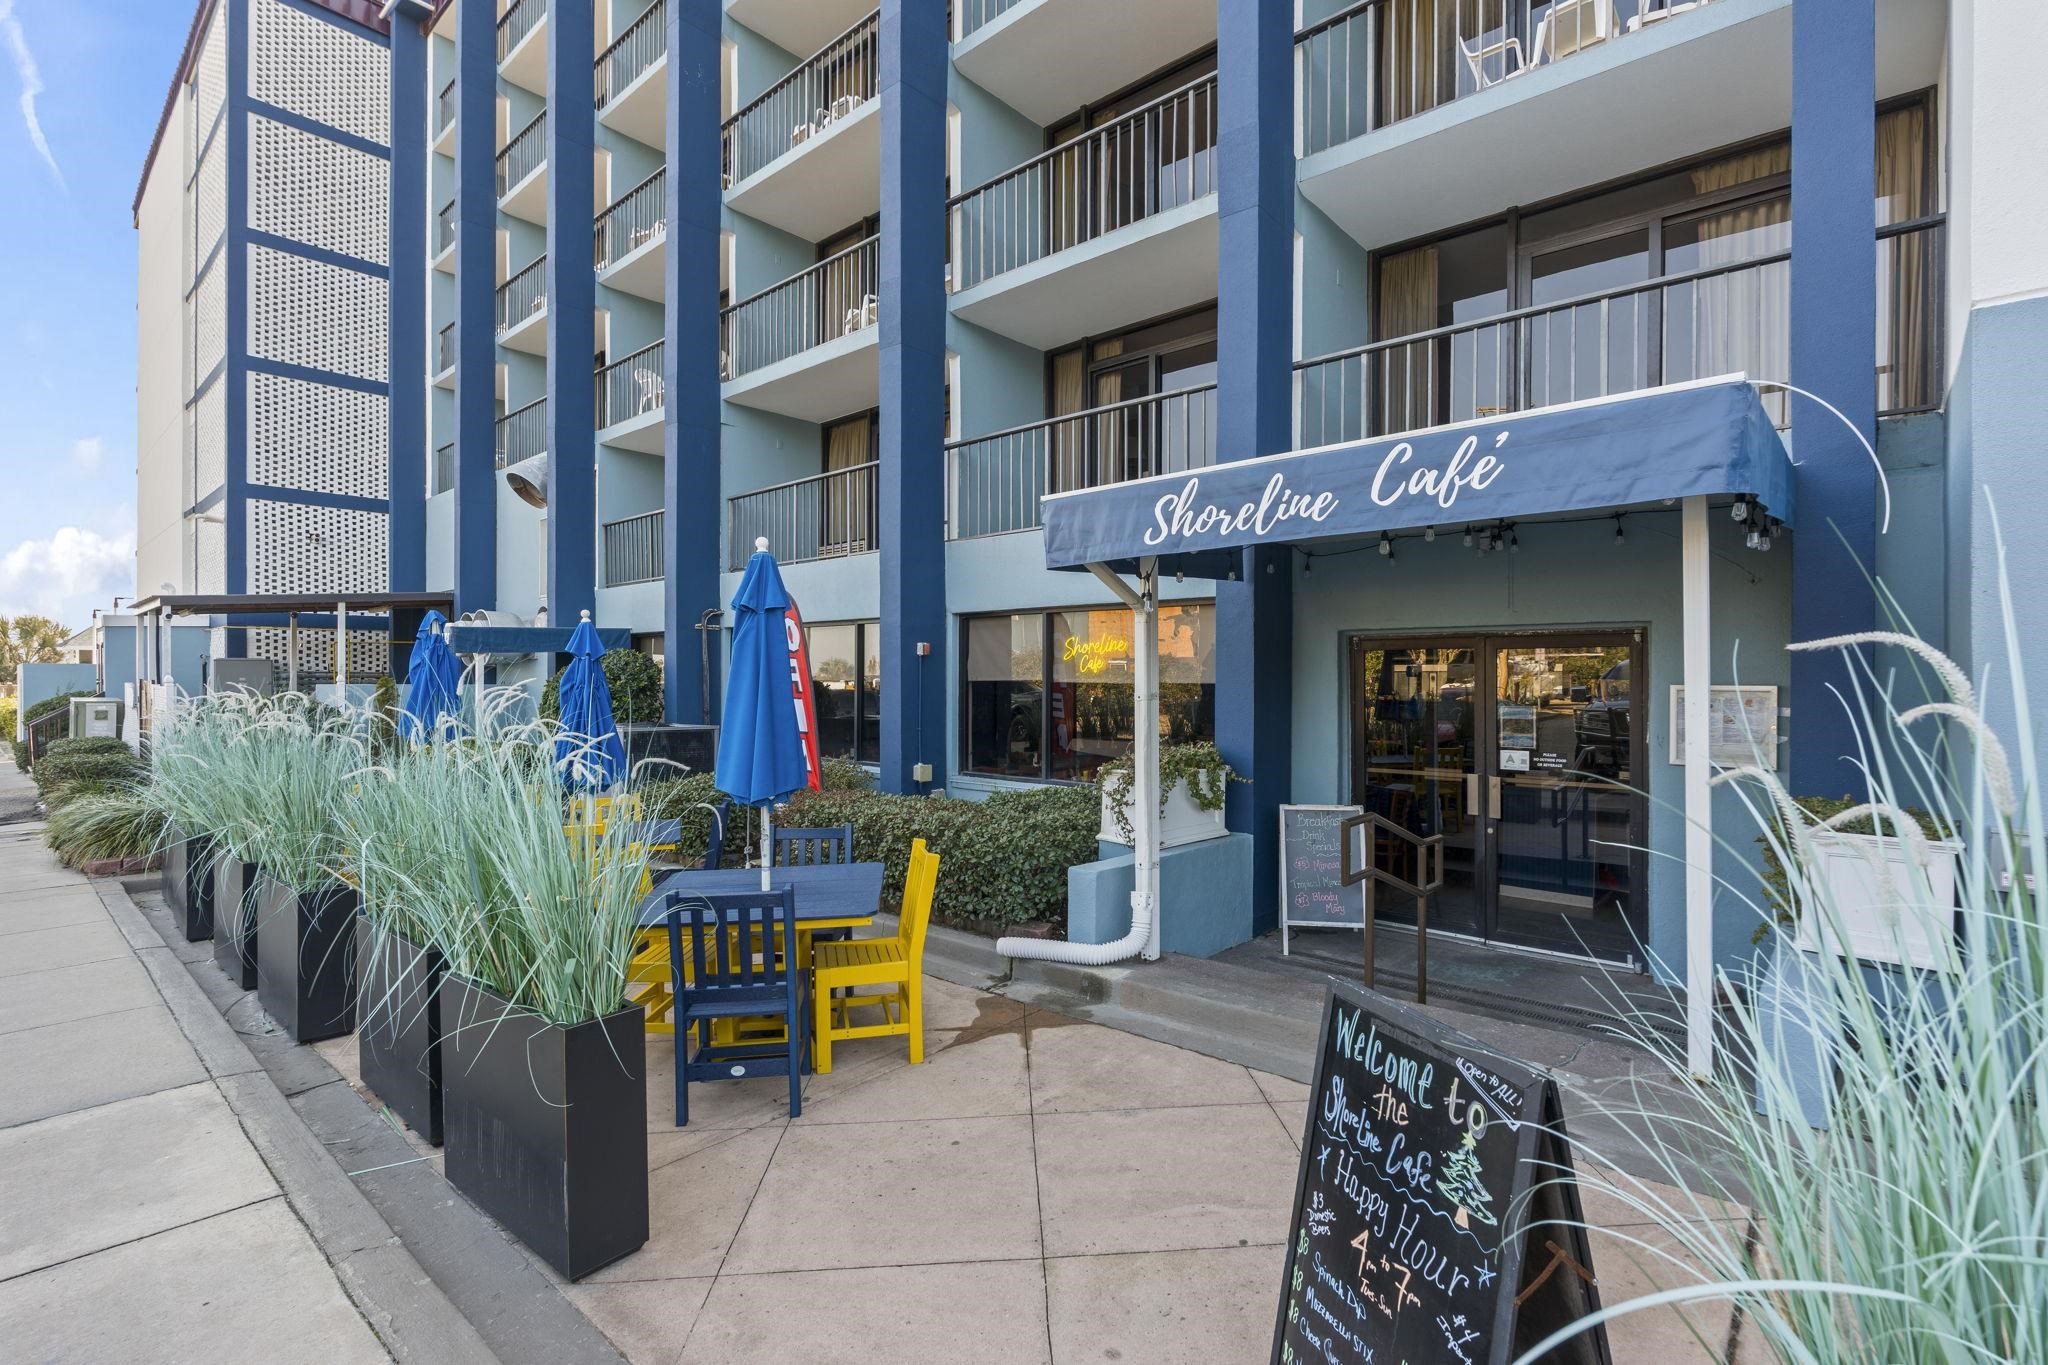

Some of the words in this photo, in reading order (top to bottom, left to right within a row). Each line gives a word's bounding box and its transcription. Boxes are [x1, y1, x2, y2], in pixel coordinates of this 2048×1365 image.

[1143, 472, 1338, 546] Shoreline
[1370, 431, 1510, 508] Café
[1063, 633, 1127, 660] Shoreline
[1080, 654, 1104, 673] Cafe
[1302, 829, 1325, 841] Drink
[1312, 891, 1339, 905] Bloody
[1325, 903, 1345, 915] Mary
[1336, 1007, 1433, 1110] Welcome
[1443, 1077, 1488, 1140] to
[1464, 1062, 1487, 1082] Open
[1488, 1074, 1500, 1087] to
[1372, 1083, 1410, 1126] the
[1386, 1132, 1433, 1194] Cafe
[1312, 1191, 1324, 1210] $3
[1309, 1222, 1331, 1236] Beers
[1334, 1149, 1389, 1238] Happy
[1389, 1203, 1470, 1297] Hour
[1297, 1228, 1310, 1257] $8
[1312, 1251, 1345, 1300] Spinach
[1346, 1284, 1367, 1320] Dip
[1380, 1254, 1390, 1272] to
[1292, 1264, 1304, 1292] $8
[1288, 1299, 1300, 1324] $8
